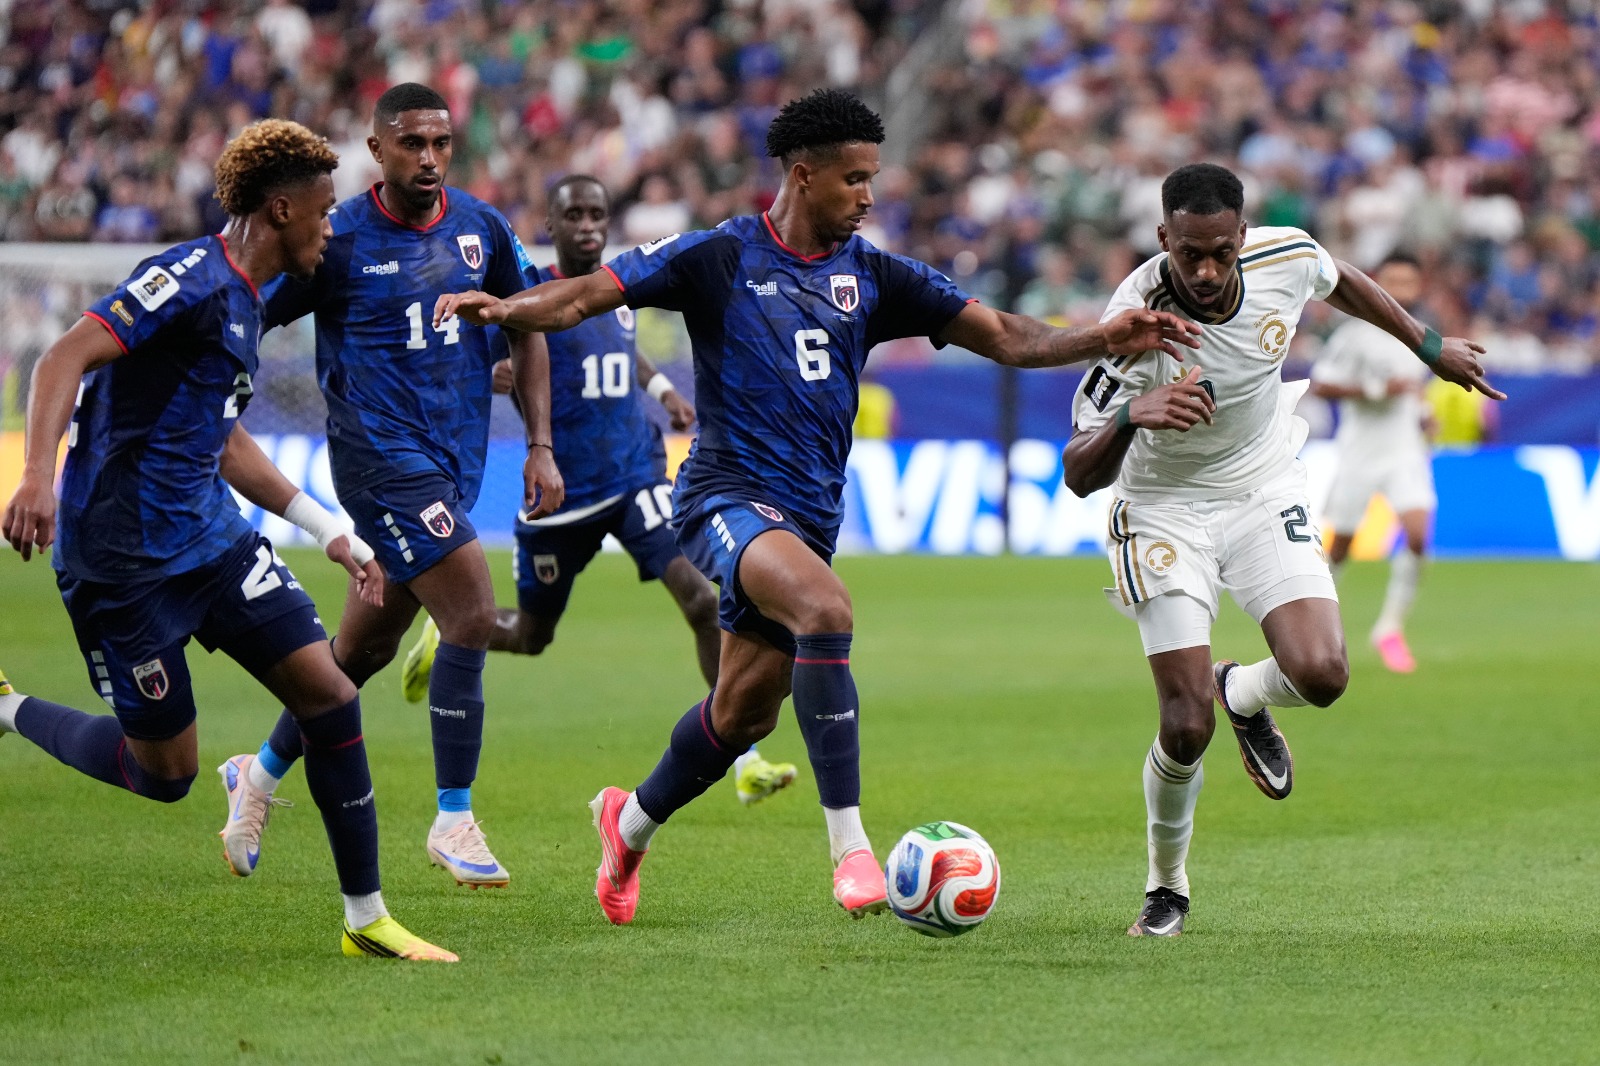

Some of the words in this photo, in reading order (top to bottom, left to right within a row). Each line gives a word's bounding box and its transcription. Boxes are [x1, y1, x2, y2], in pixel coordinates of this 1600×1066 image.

[362, 260, 399, 275] capelli
[746, 280, 777, 292] cpelli
[405, 302, 460, 349] 14
[794, 328, 832, 382] 6
[581, 352, 630, 399] 10
[135, 661, 158, 676] FCF
